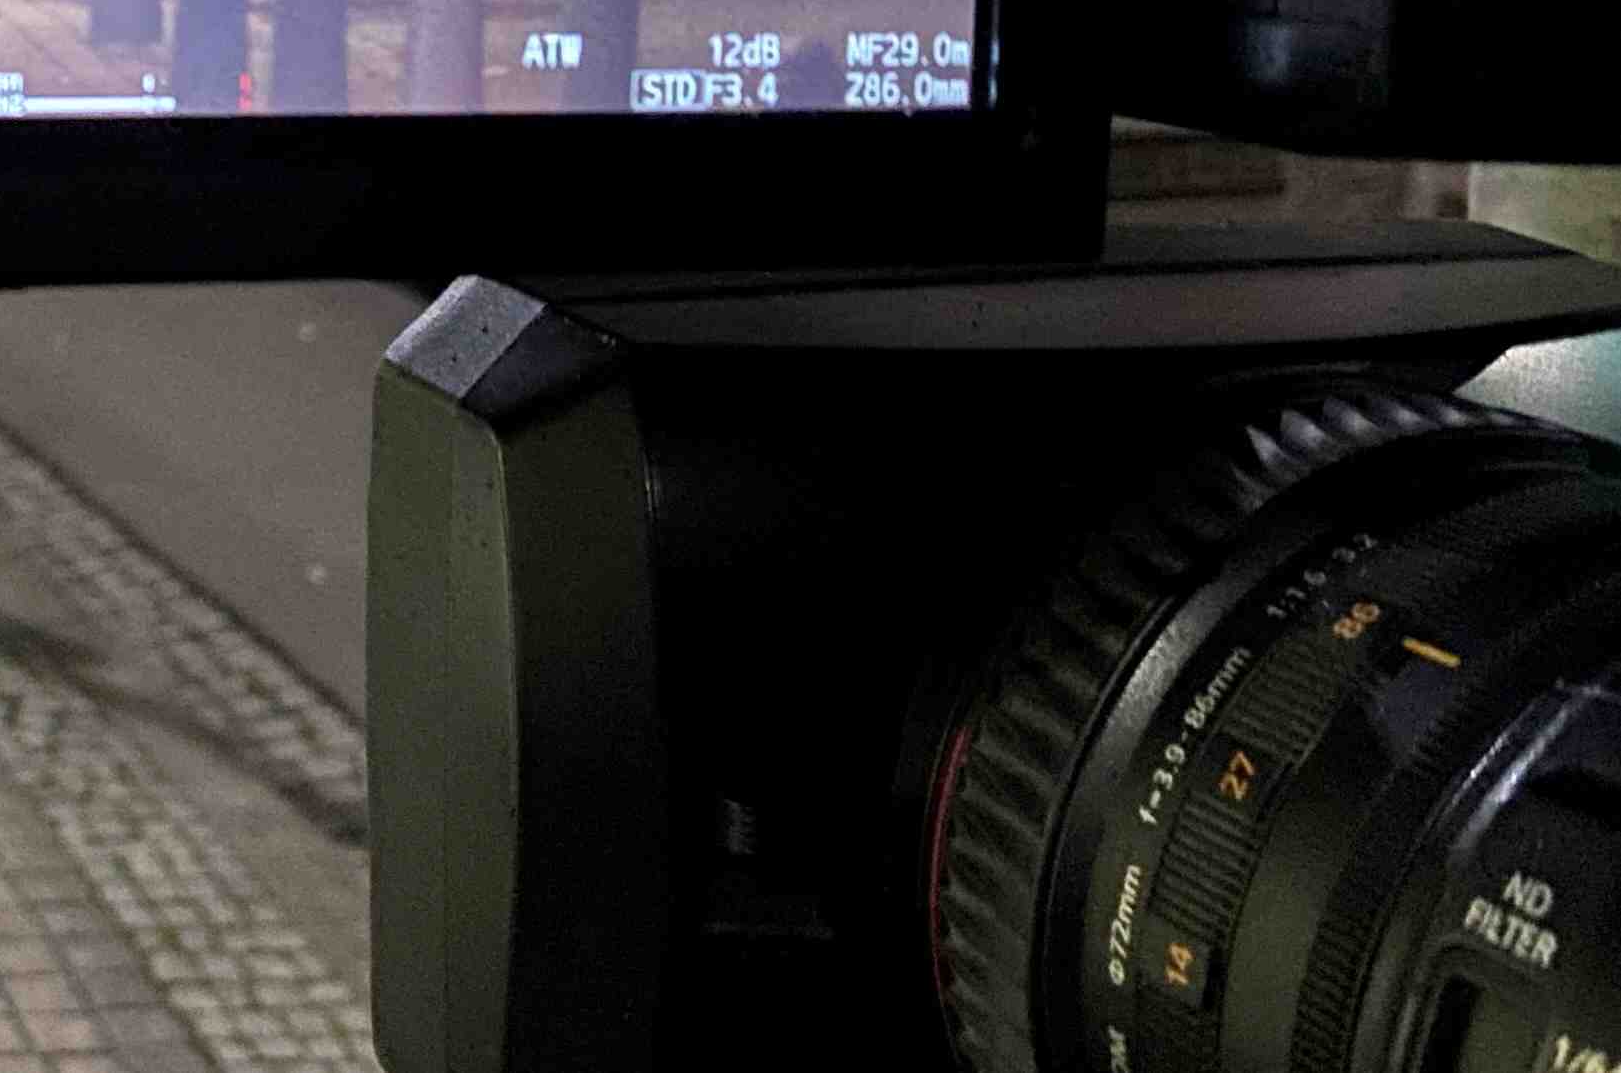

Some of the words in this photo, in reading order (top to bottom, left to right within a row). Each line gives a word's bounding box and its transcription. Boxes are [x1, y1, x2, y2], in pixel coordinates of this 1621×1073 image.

[521, 33, 583, 69] ATW
[709, 33, 780, 68] 12dB
[704, 73, 779, 108] F3.4
[1217, 749, 1257, 801] 27
[1503, 870, 1554, 918] ND
[1464, 895, 1558, 969] FILTER
[1164, 943, 1195, 986] 14
